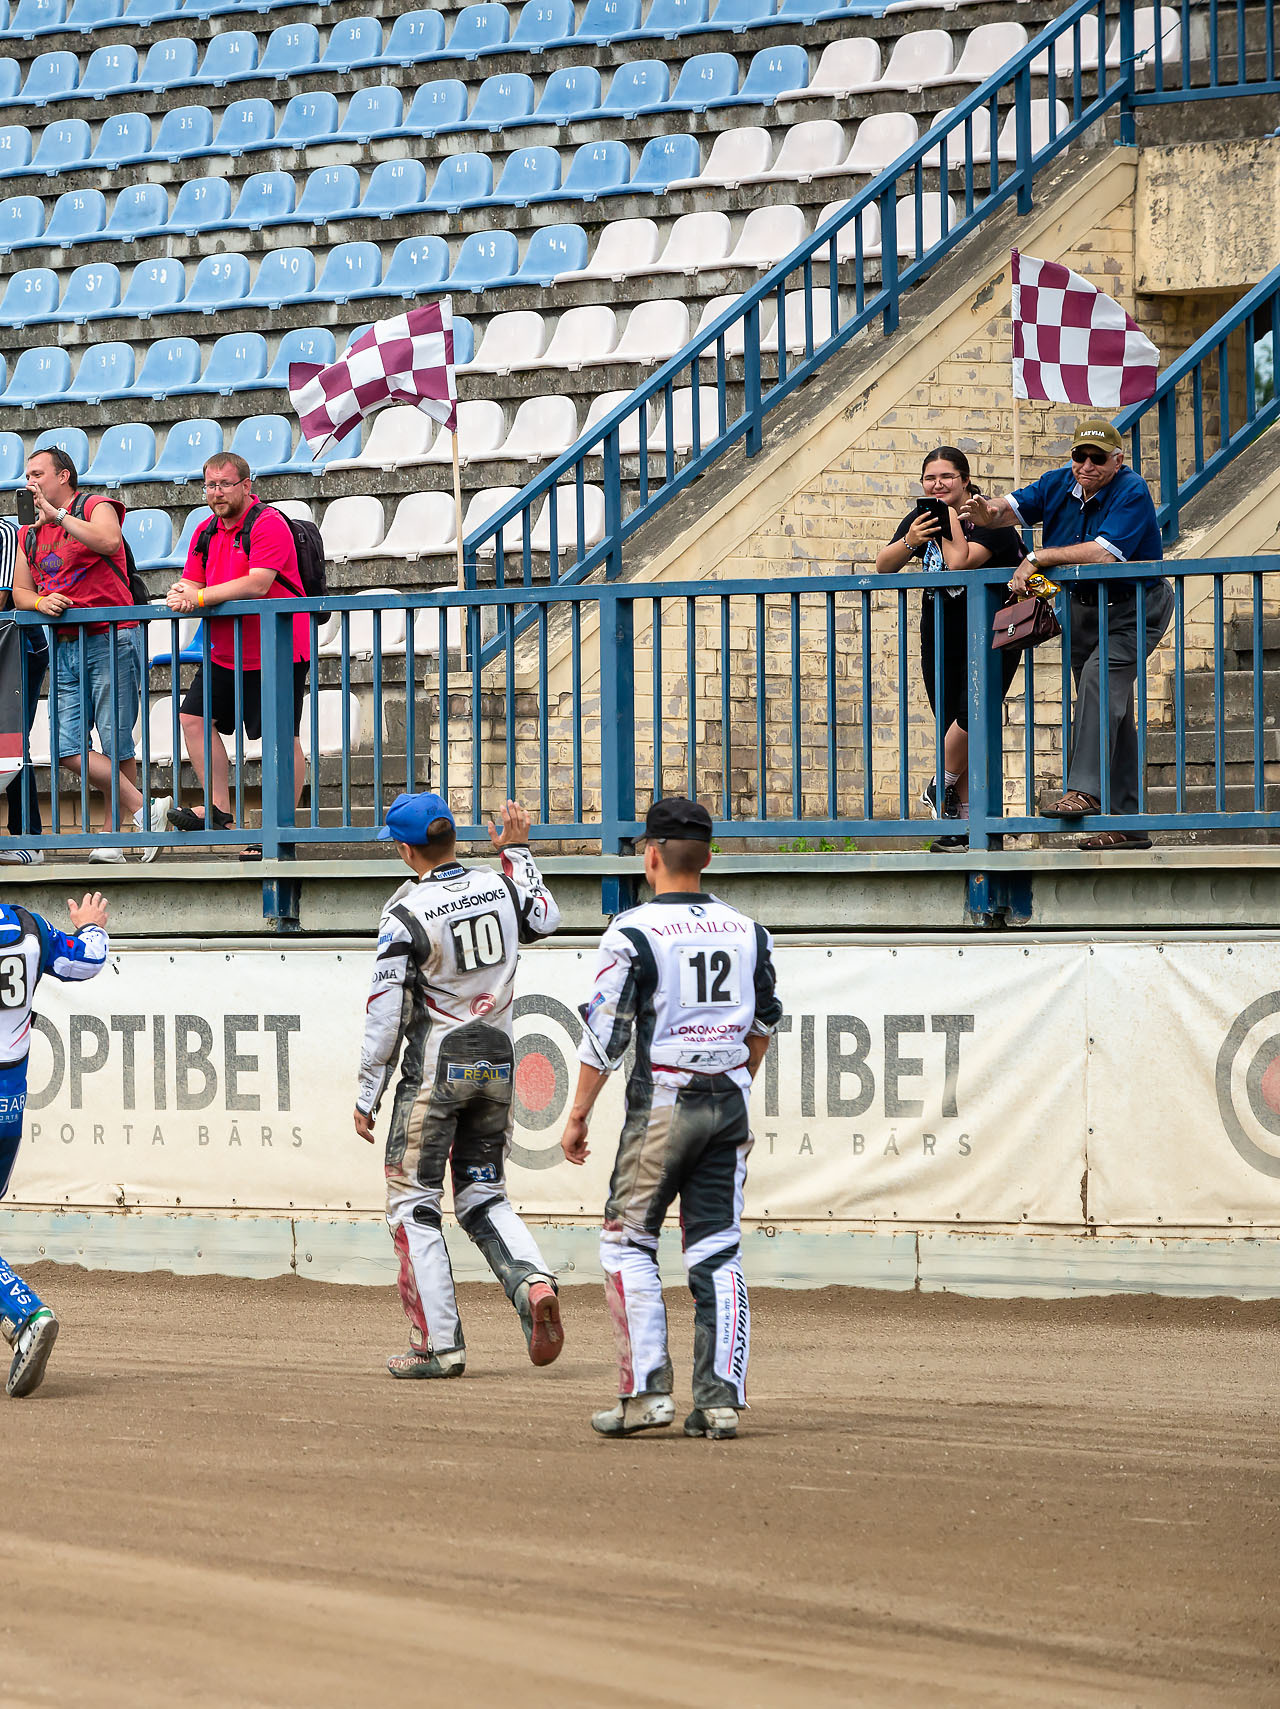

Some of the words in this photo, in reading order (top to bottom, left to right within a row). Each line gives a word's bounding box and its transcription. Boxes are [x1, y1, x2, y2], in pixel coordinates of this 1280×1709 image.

[537, 9, 553, 21] 39
[349, 27, 361, 41] 36
[409, 22, 425, 35] 37
[228, 41, 240, 54] 34
[49, 62, 60, 74] 31
[105, 55, 120, 68] 32
[769, 59, 783, 72] 44
[700, 68, 714, 81] 43
[565, 78, 576, 90] 41
[180, 117, 193, 130] 35
[241, 111, 254, 123] 36
[117, 123, 129, 136] 34
[592, 148, 607, 161] 43
[663, 142, 675, 155] 44
[523, 157, 537, 171] 42
[194, 186, 207, 201] 37
[73, 197, 85, 210] 35
[478, 241, 497, 258] 43
[548, 238, 567, 253] 44
[410, 245, 429, 265] 42
[279, 253, 299, 274] 40
[345, 255, 362, 270] 41
[211, 263, 232, 280] 39
[24, 278, 42, 293] 36
[85, 273, 103, 292] 37
[235, 347, 246, 360] 41
[300, 340, 314, 355] 42
[424, 888, 506, 921] MATJUŠONOKS
[452, 914, 503, 971] 10
[688, 950, 732, 1003] 12
[670, 1024, 746, 1036] LOKOMOTIV
[764, 1014, 975, 1118] TIBET
[30, 1122, 165, 1146] PORTA
[198, 1119, 303, 1148] BĀRS
[852, 1127, 972, 1157] BĀRS
